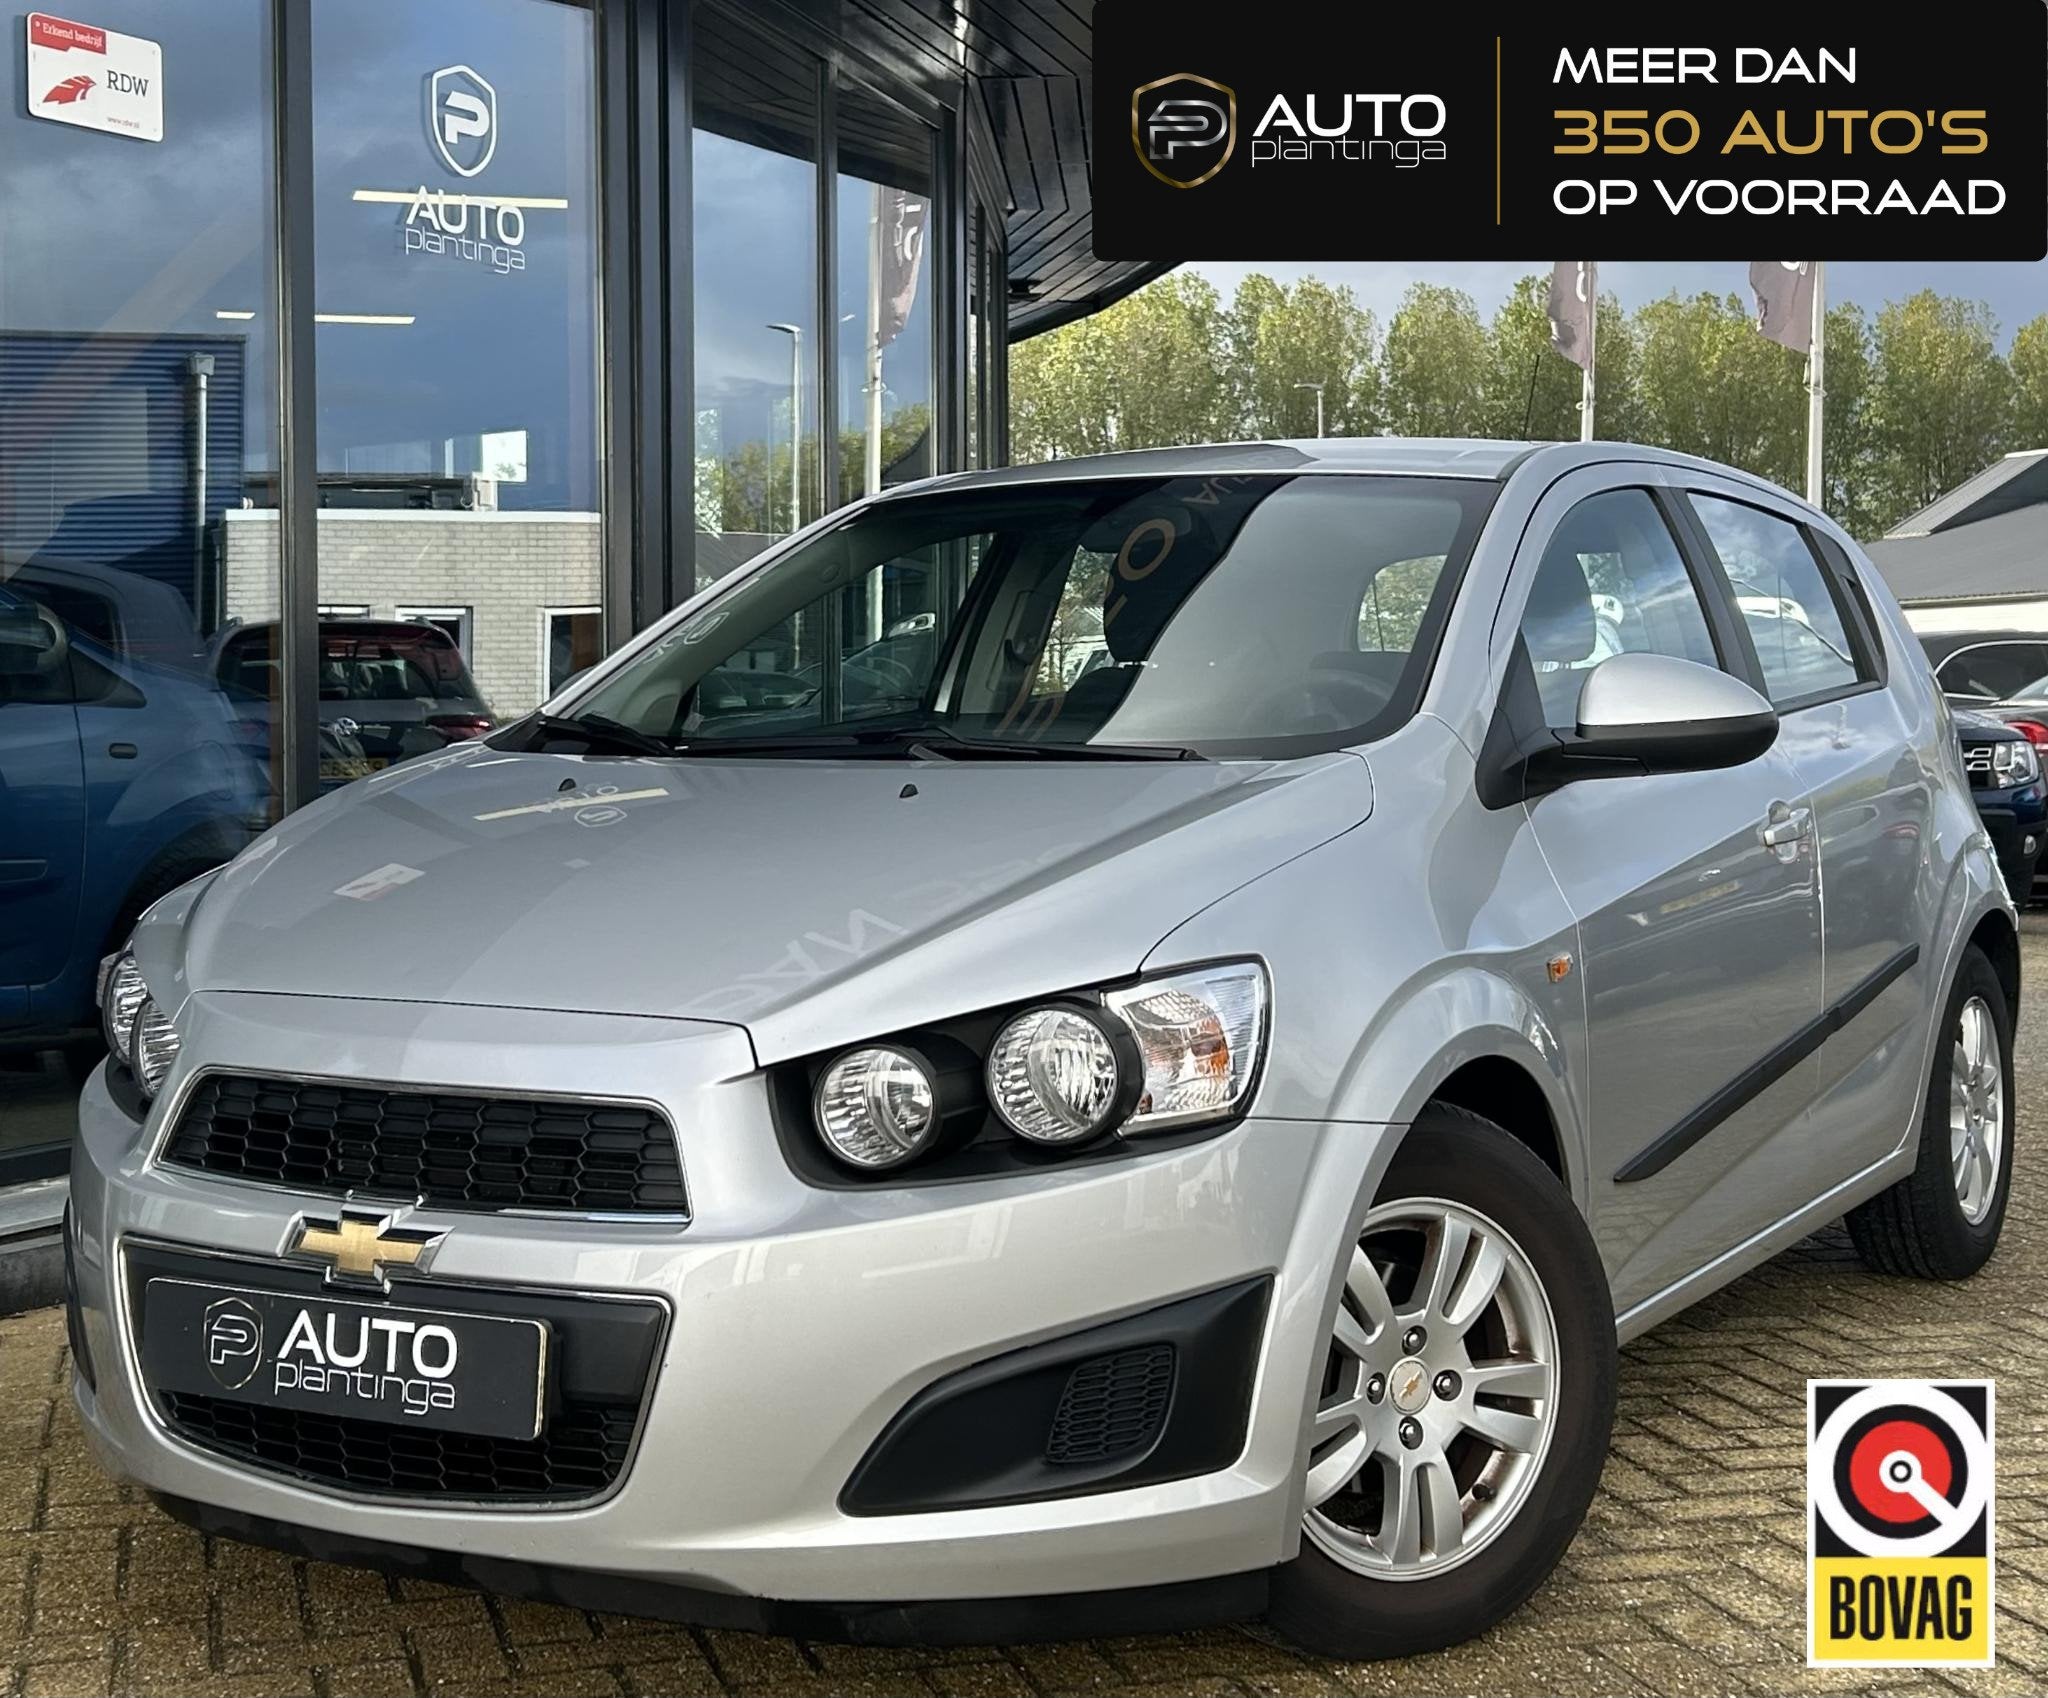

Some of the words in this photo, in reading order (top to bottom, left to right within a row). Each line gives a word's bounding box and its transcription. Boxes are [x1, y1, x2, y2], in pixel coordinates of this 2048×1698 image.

[43, 22, 74, 41] Erkend
[75, 30, 103, 49] bedrijf
[106, 69, 150, 98] RDW
[405, 184, 525, 247] AUTO
[404, 226, 526, 275] plantinga
[276, 1308, 459, 1379] AUTO
[274, 1357, 456, 1416] plantinga
